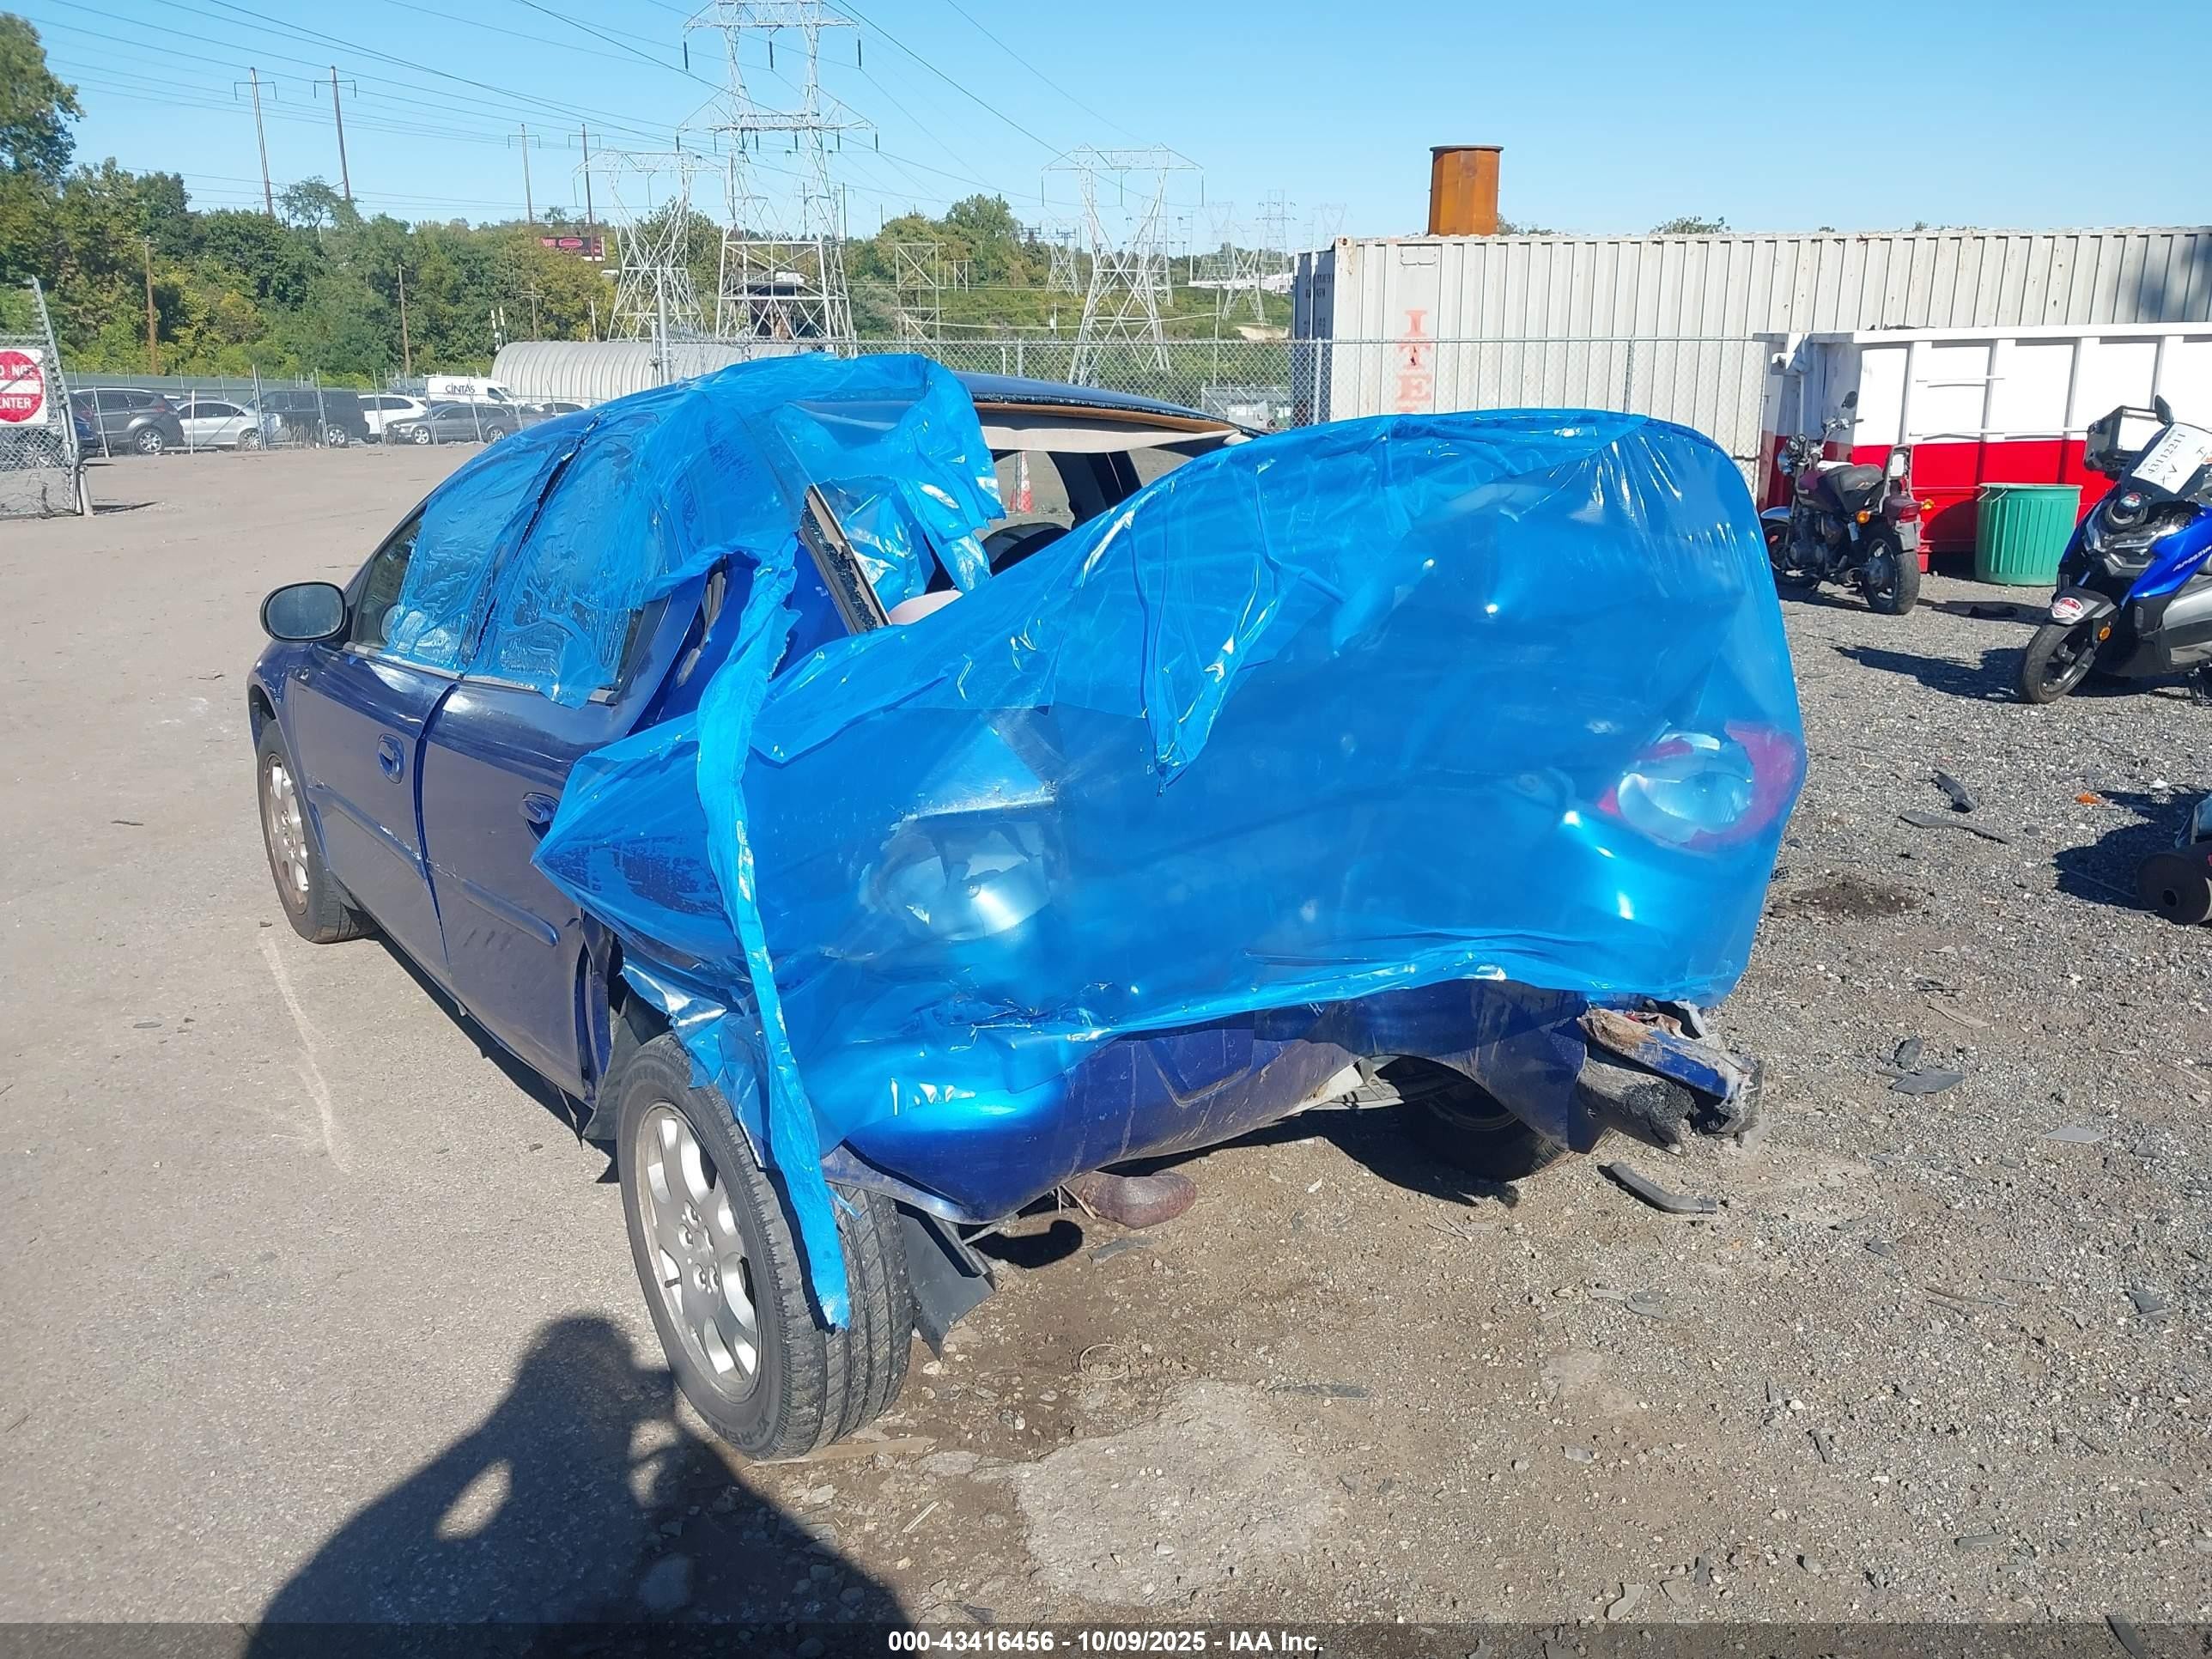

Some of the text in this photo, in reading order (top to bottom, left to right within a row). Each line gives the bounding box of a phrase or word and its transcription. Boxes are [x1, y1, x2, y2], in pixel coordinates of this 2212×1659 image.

[1395, 310, 1431, 413] ITE
[445, 383, 476, 395] CINTAS
[0, 397, 32, 410] NTER
